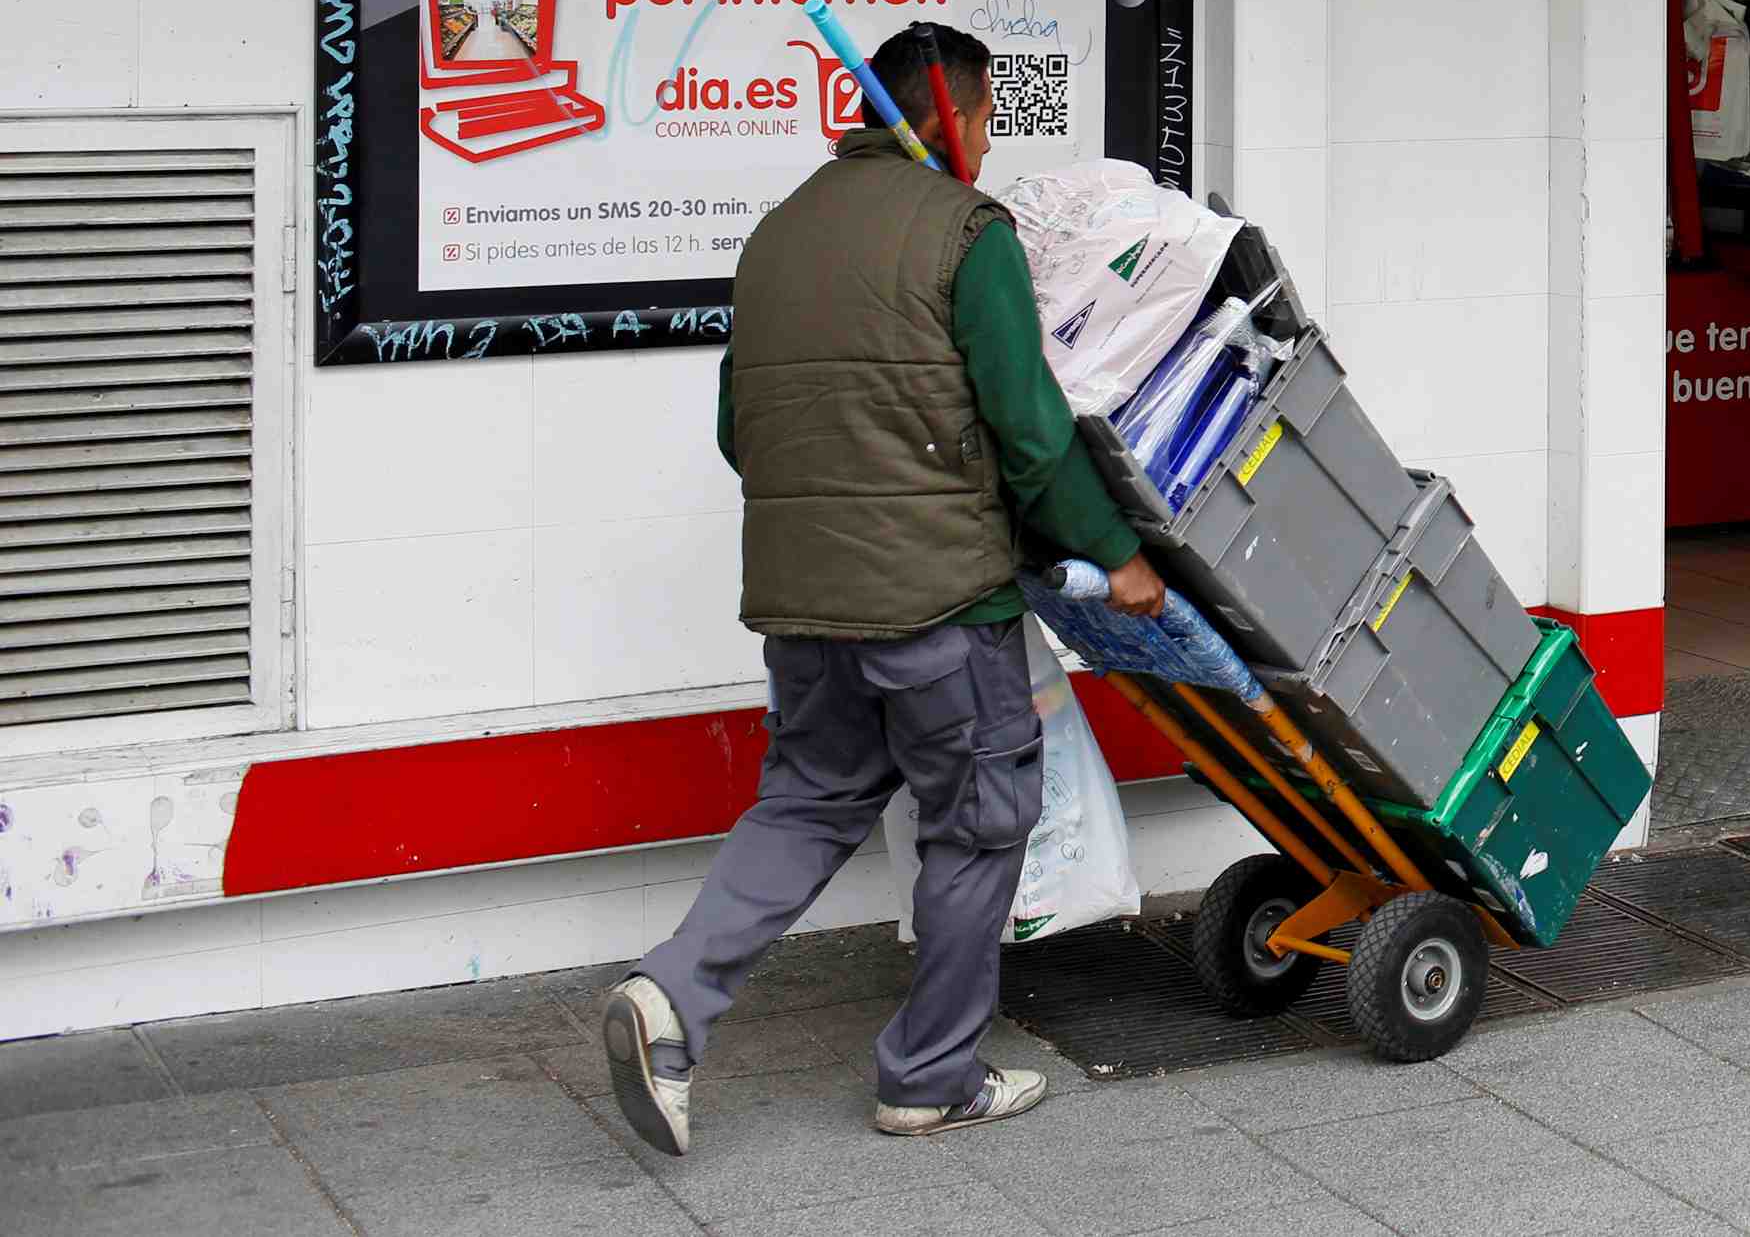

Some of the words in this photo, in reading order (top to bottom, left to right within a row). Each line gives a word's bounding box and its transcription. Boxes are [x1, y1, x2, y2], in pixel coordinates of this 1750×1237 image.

[655, 67, 798, 112] dia.es
[655, 119, 732, 138] COMPRA
[737, 119, 798, 137] ONLINE
[466, 204, 561, 225] Enviamos
[567, 206, 592, 221] un
[598, 202, 641, 220] SMS
[648, 199, 706, 219] 20-30
[712, 197, 753, 216] min.
[466, 237, 481, 261] Si
[487, 239, 539, 265] pides
[545, 236, 597, 258] antes
[602, 234, 626, 255] de
[632, 234, 658, 255] las
[664, 235, 683, 253] 12
[689, 234, 705, 252] h.
